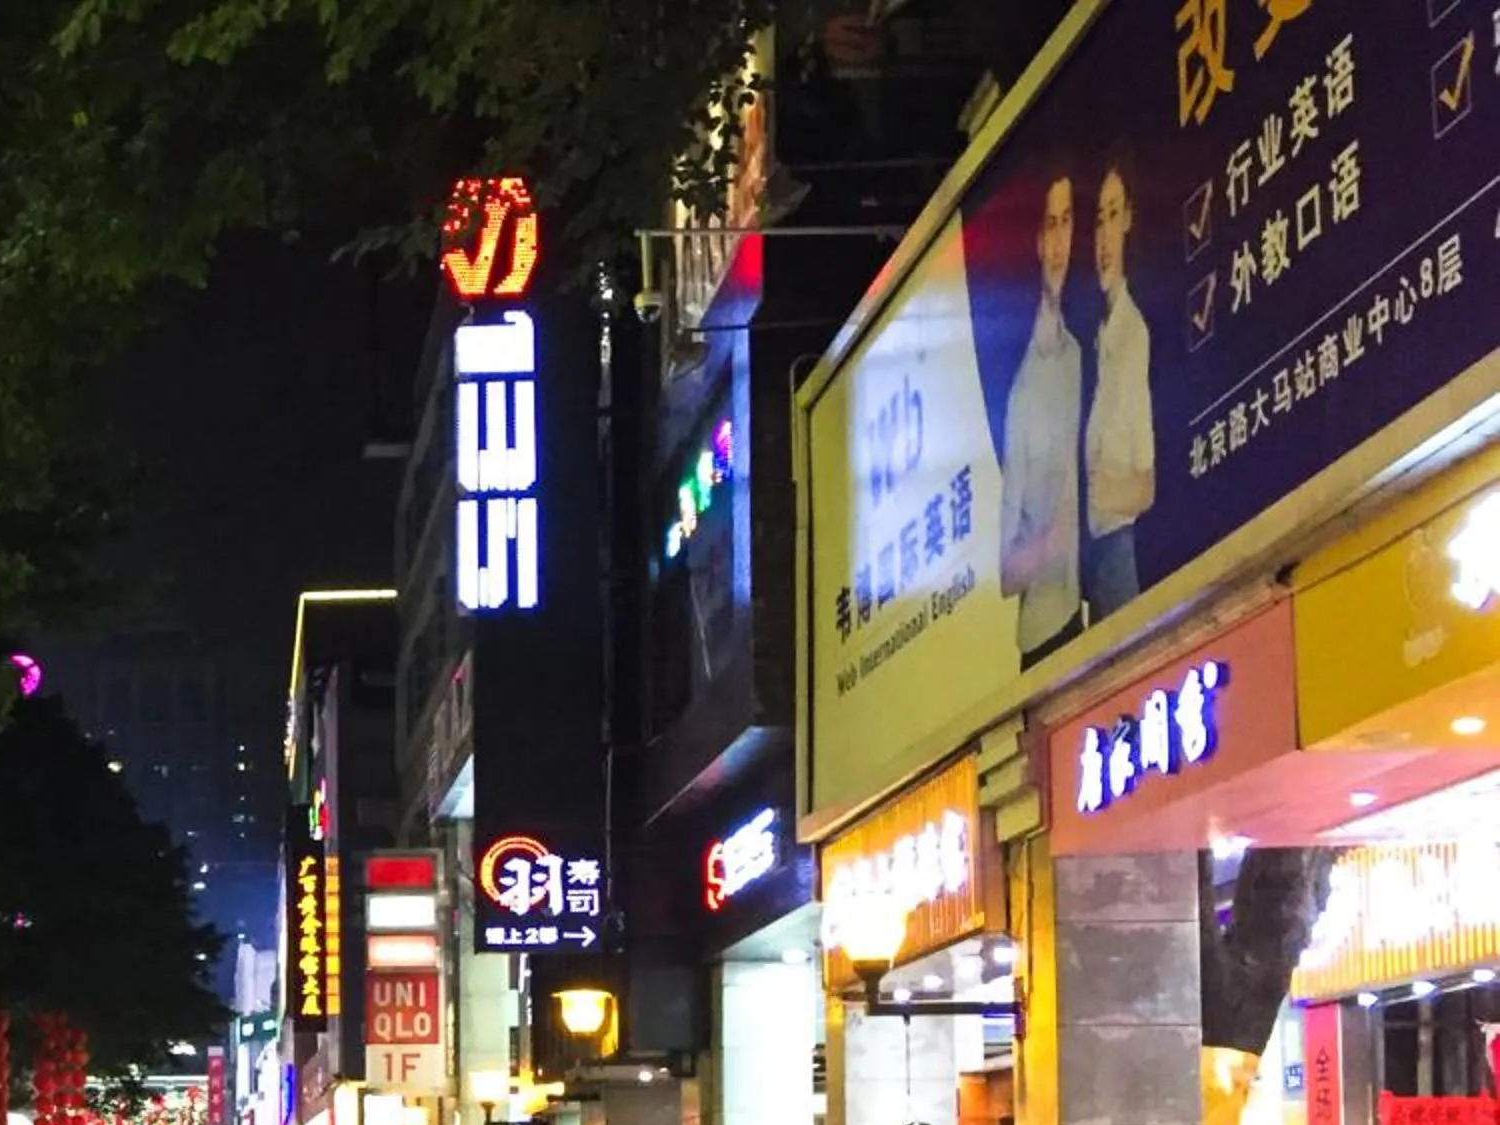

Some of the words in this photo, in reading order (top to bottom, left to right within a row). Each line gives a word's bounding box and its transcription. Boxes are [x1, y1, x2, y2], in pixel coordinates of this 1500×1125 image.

[1225, 31, 1355, 218] 行业英语
[1229, 139, 1361, 315] 外教口语
[1188, 232, 1463, 480] 北京路大马站商业中心8层
[373, 981, 428, 1007] UNI
[373, 1011, 432, 1041] QLO
[382, 1052, 422, 1084] 1F
